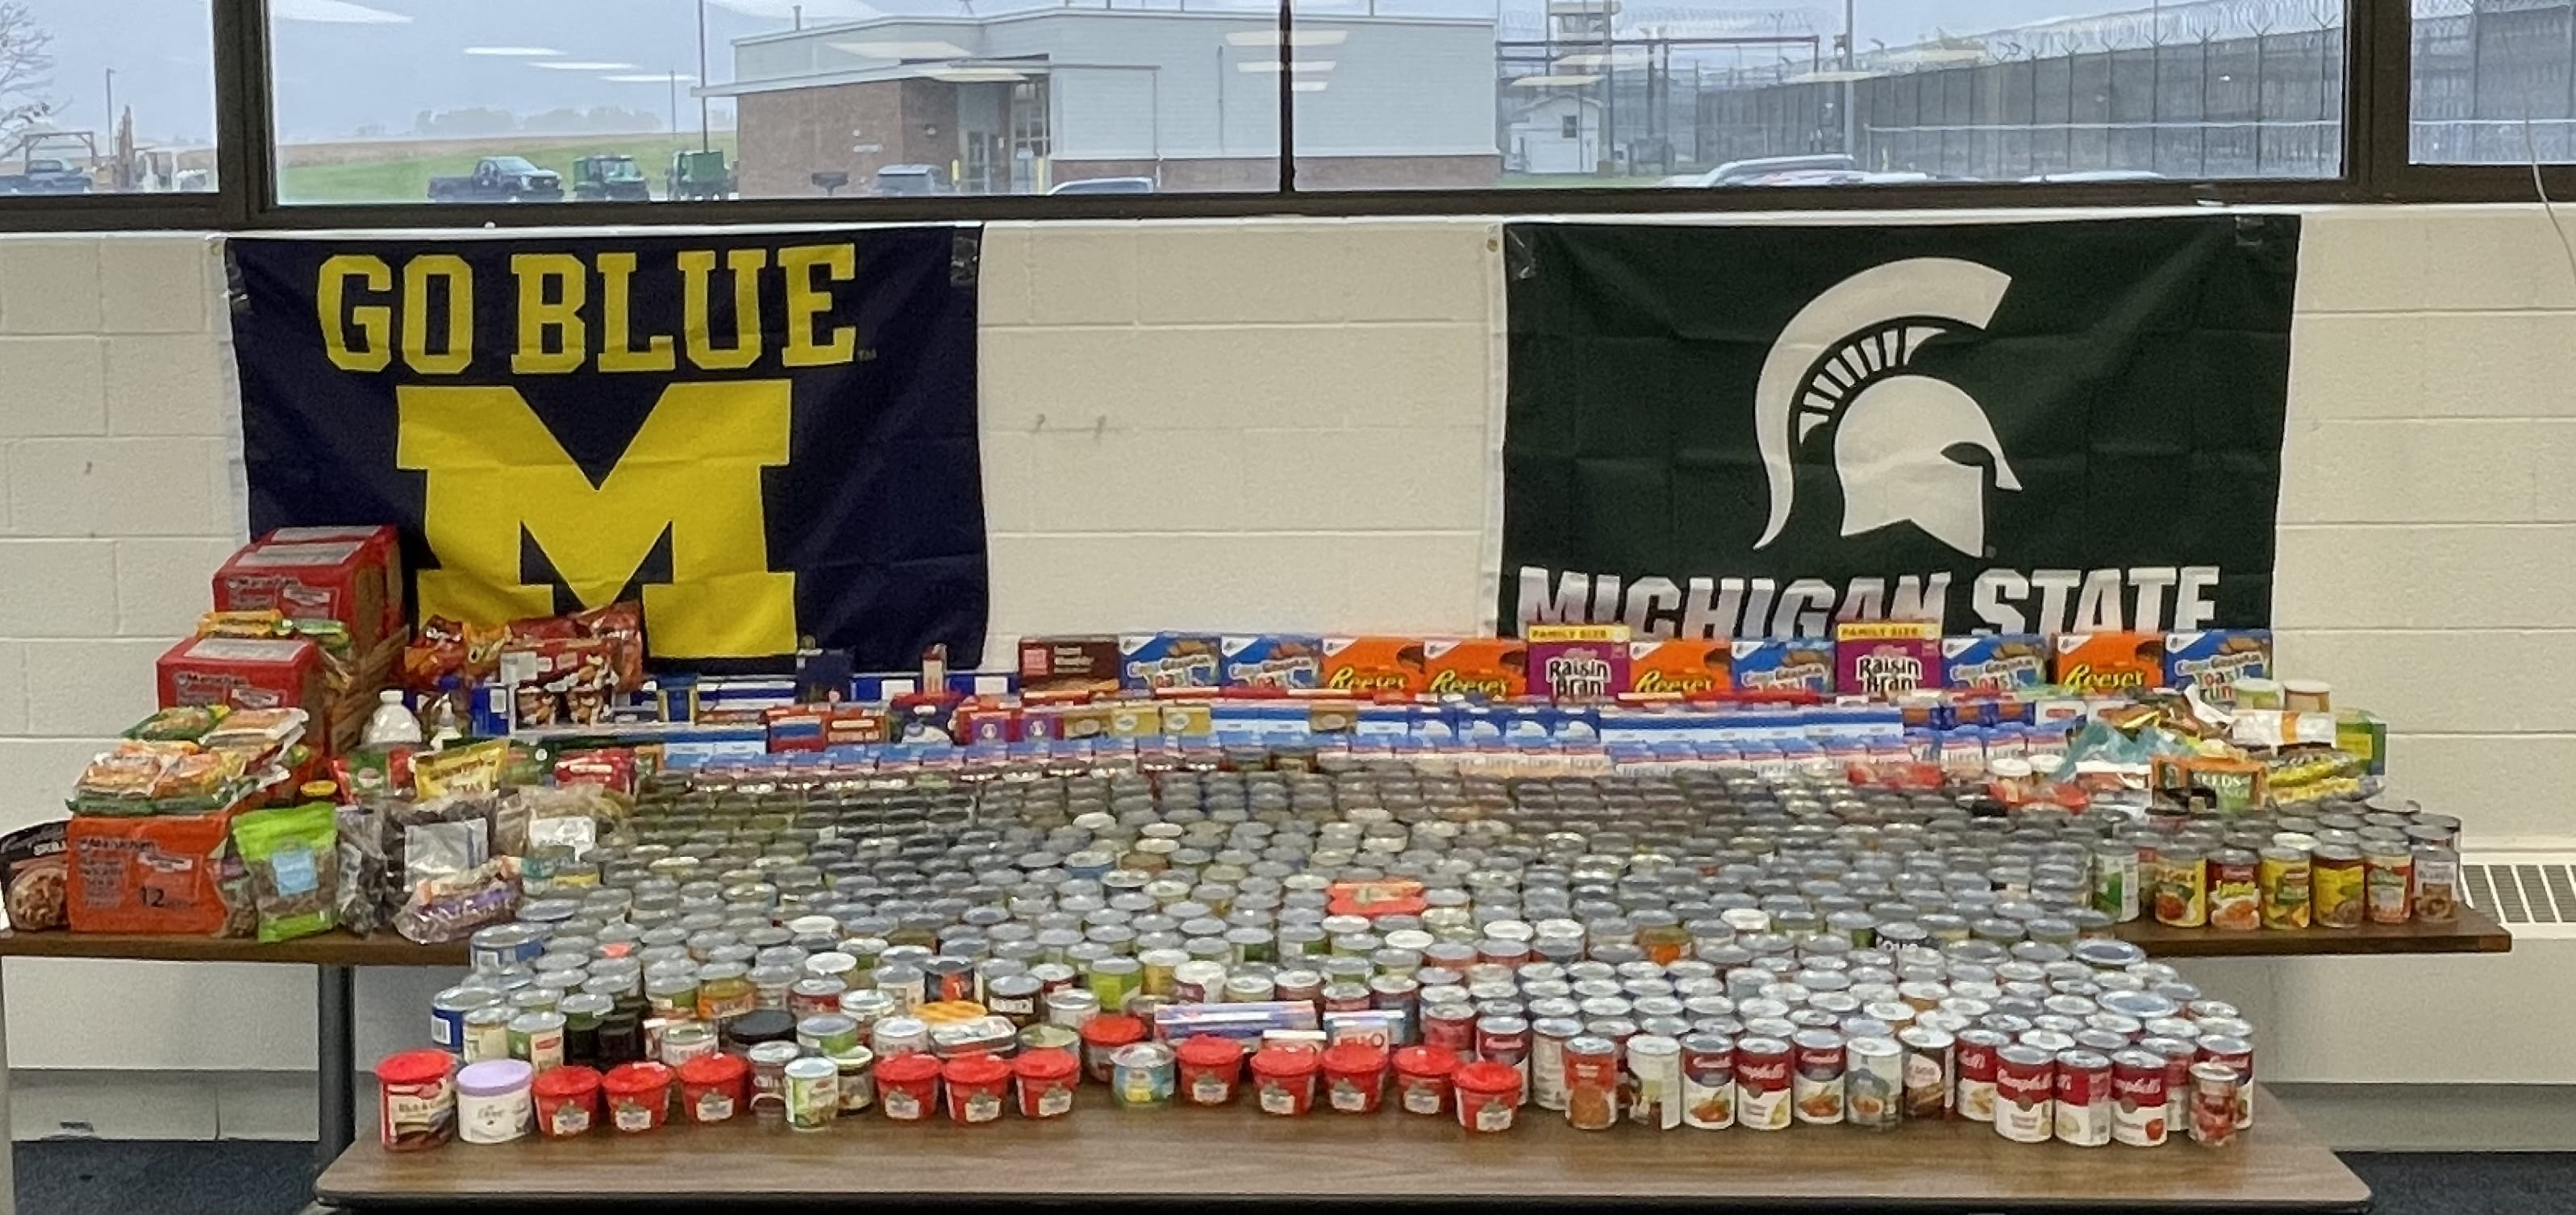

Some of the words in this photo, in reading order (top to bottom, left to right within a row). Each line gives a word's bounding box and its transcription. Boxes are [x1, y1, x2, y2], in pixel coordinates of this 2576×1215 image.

[318, 255, 473, 375] GO
[510, 243, 857, 376] BLUE
[395, 378, 799, 660] M
[1972, 566, 2221, 637] STATE
[1549, 660, 1609, 677] Raisin
[1858, 657, 1920, 676] Raisin
[140, 885, 165, 909] 12
